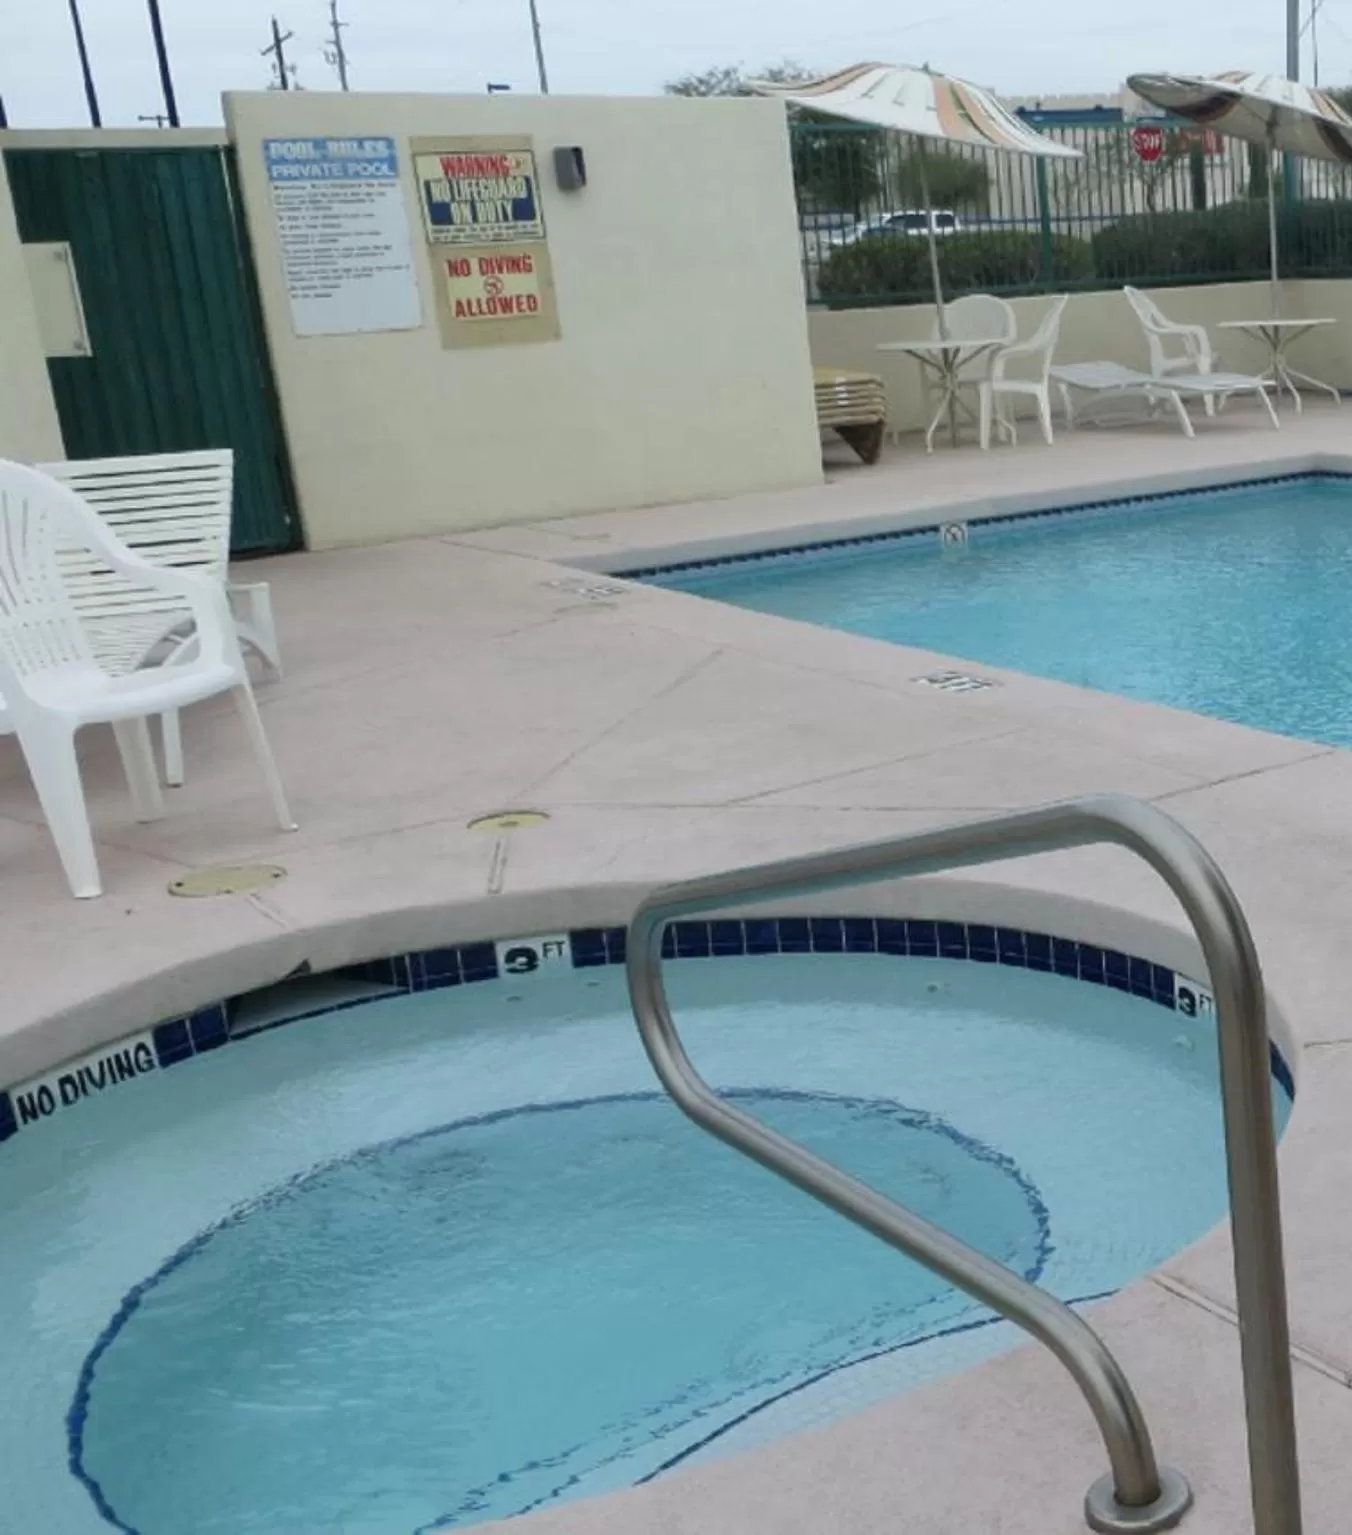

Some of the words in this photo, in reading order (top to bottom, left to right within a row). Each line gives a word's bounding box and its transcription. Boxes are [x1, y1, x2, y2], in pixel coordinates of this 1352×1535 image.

[269, 141, 317, 160] POOL
[271, 162, 342, 178] PRIVATE
[347, 161, 396, 177] POOL
[440, 155, 509, 178] WARNING
[430, 180, 452, 203] NO
[453, 175, 528, 202] LIFEGUARD
[450, 200, 473, 226] ON
[475, 198, 515, 223] DUTY
[446, 257, 472, 278] NO
[478, 252, 533, 277] DIVING
[455, 293, 538, 318] ALLOWED
[504, 946, 539, 974] 3
[542, 940, 565, 960] FT
[1178, 986, 1197, 1018] 3
[15, 1083, 56, 1125] NO
[57, 1041, 156, 1107] DIVING
